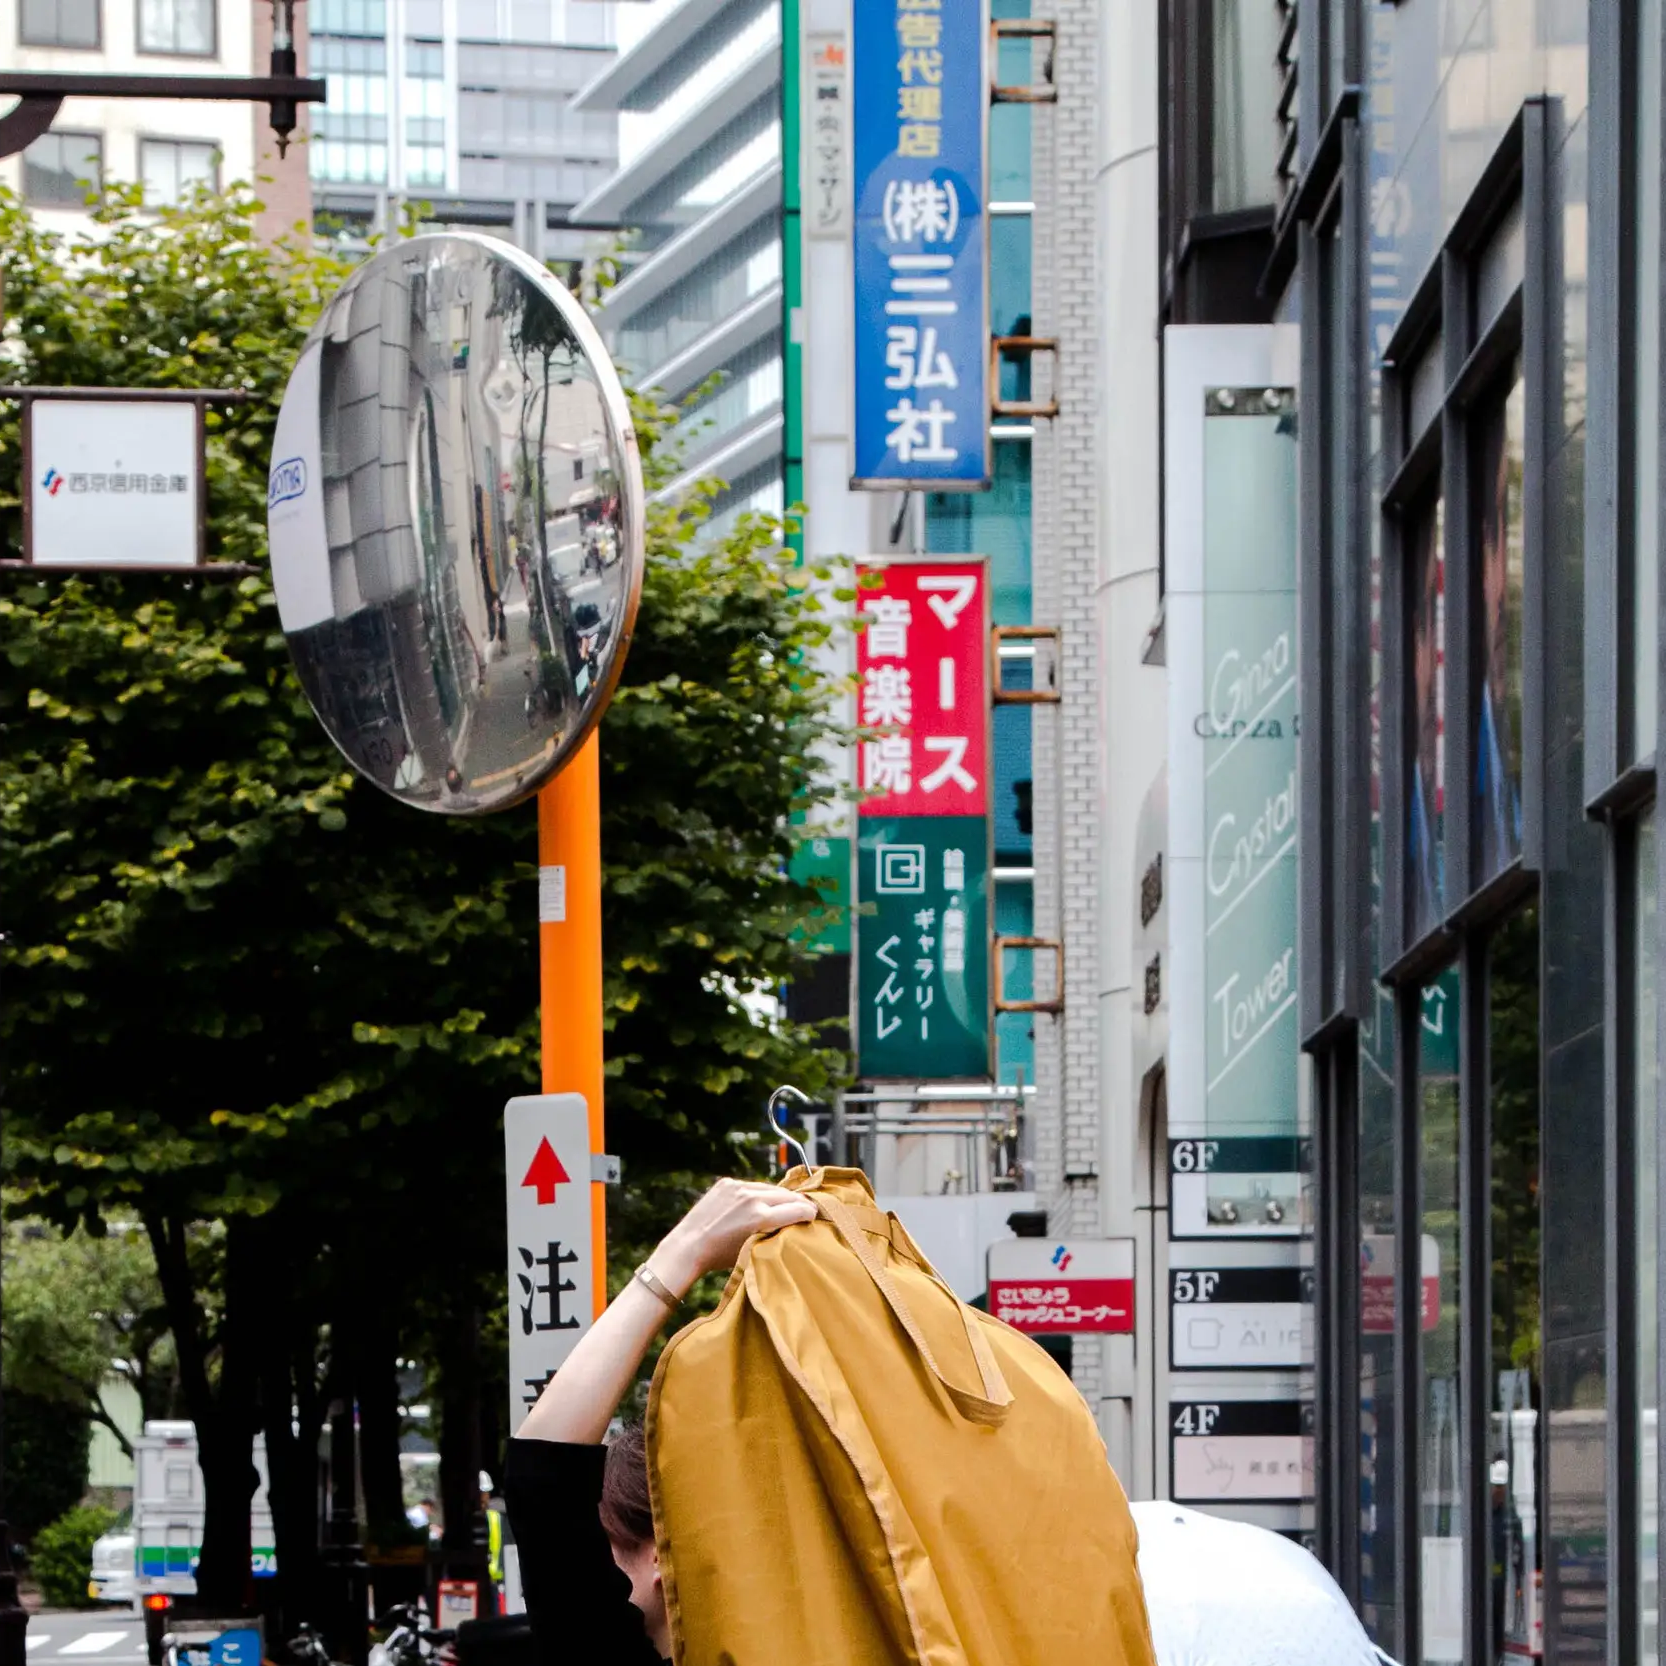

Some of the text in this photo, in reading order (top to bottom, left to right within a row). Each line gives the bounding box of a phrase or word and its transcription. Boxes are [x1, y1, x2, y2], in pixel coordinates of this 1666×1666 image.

[69, 472, 188, 495] 西京信用金庫
[863, 595, 912, 794] 音楽院
[917, 575, 977, 793] マース
[914, 907, 935, 1040] ギャラリー
[1213, 948, 1294, 1057] Tower
[1172, 1141, 1219, 1173] 6F
[997, 1287, 1070, 1305] さいきょう
[1174, 1271, 1219, 1302] 5F
[997, 1305, 1126, 1324] キャッシュコーナー
[1174, 1405, 1220, 1435] 4F
